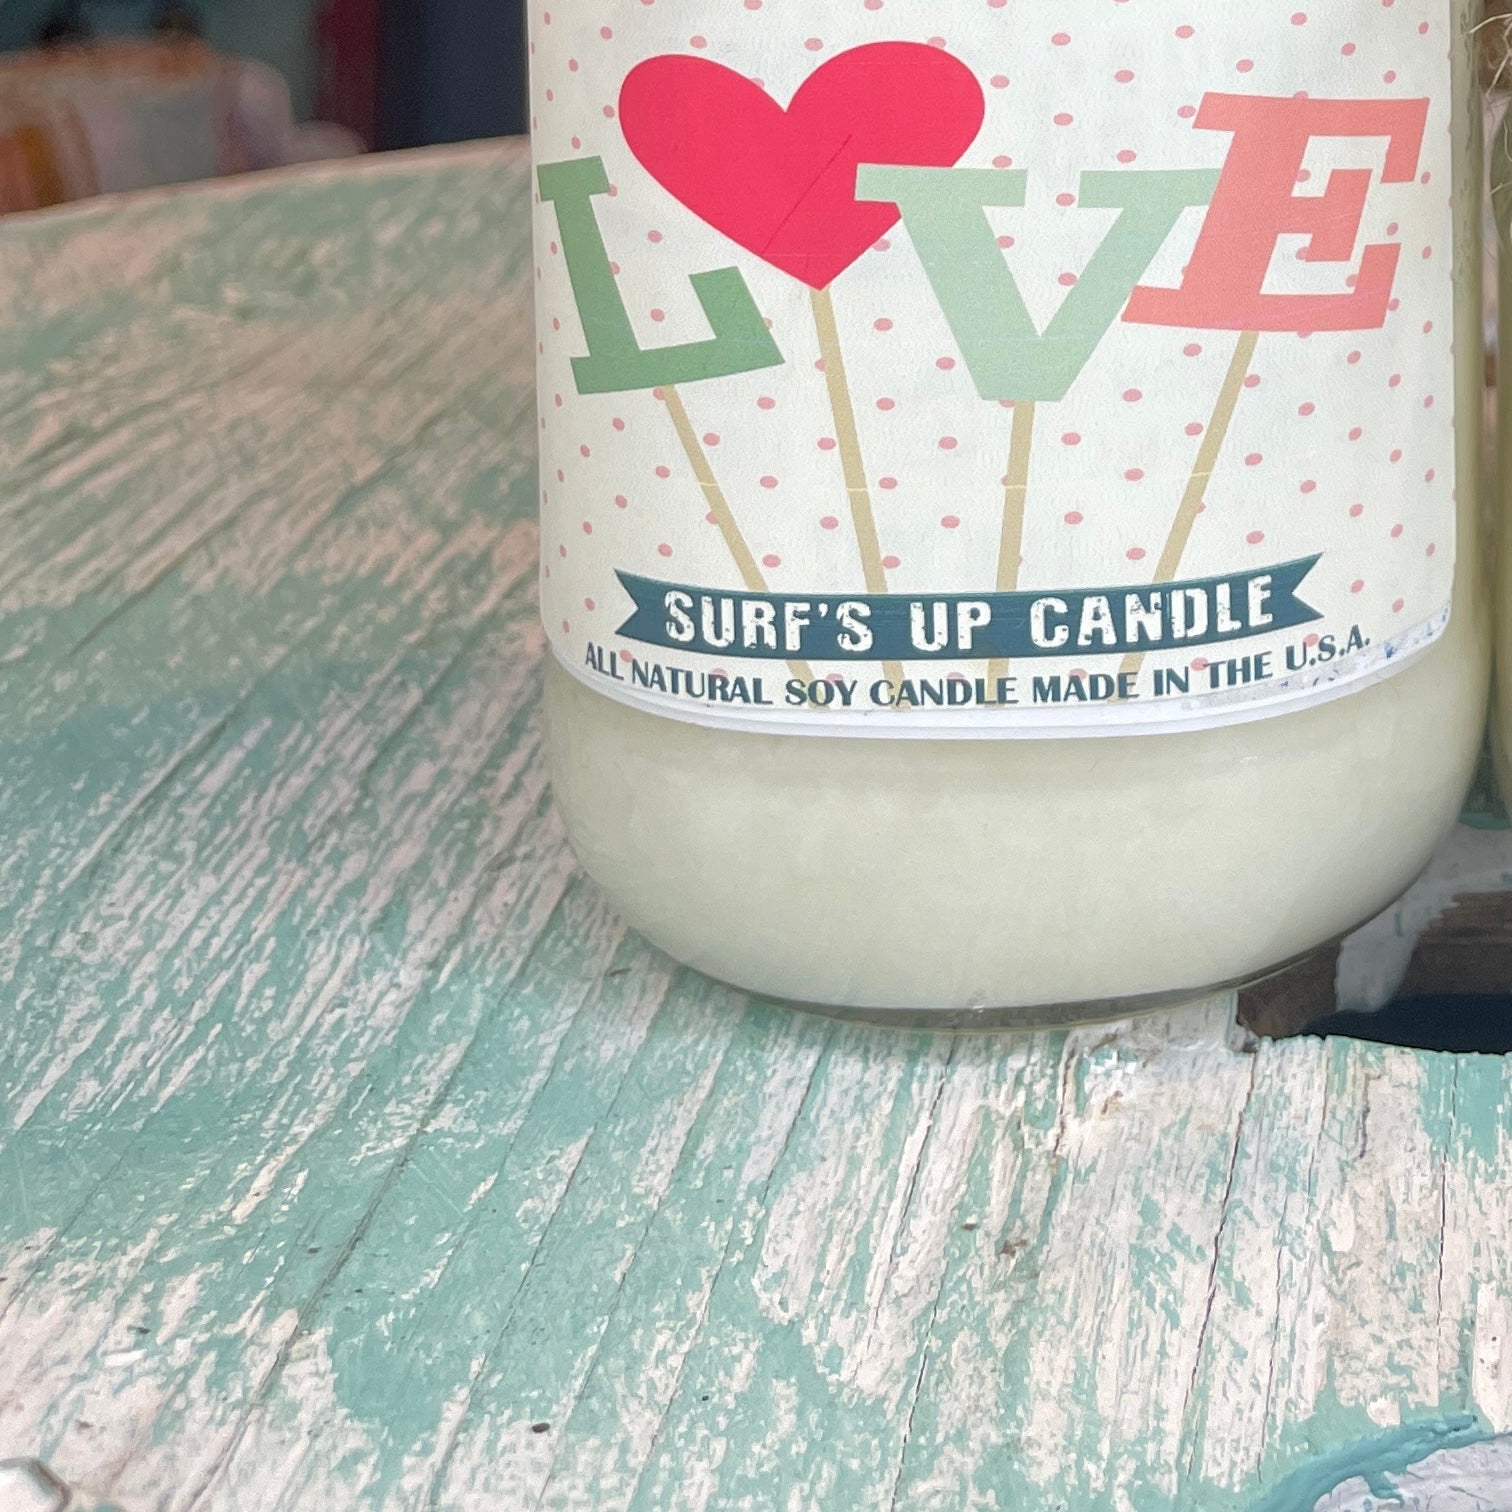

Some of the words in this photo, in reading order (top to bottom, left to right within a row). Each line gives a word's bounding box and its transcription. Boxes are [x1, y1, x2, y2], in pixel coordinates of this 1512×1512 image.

[664, 590, 876, 652] SURF'S
[910, 600, 993, 653] UP
[1029, 574, 1274, 648] CANDLE
[584, 641, 625, 683] ALL
[630, 656, 772, 706] NATURAL
[784, 678, 859, 706] SOY
[869, 677, 1018, 707] CANDLE
[1031, 673, 1140, 705] MADE
[1152, 666, 1191, 696] IN
[1204, 652, 1275, 689] THE
[1283, 623, 1371, 672] U.S.A.
